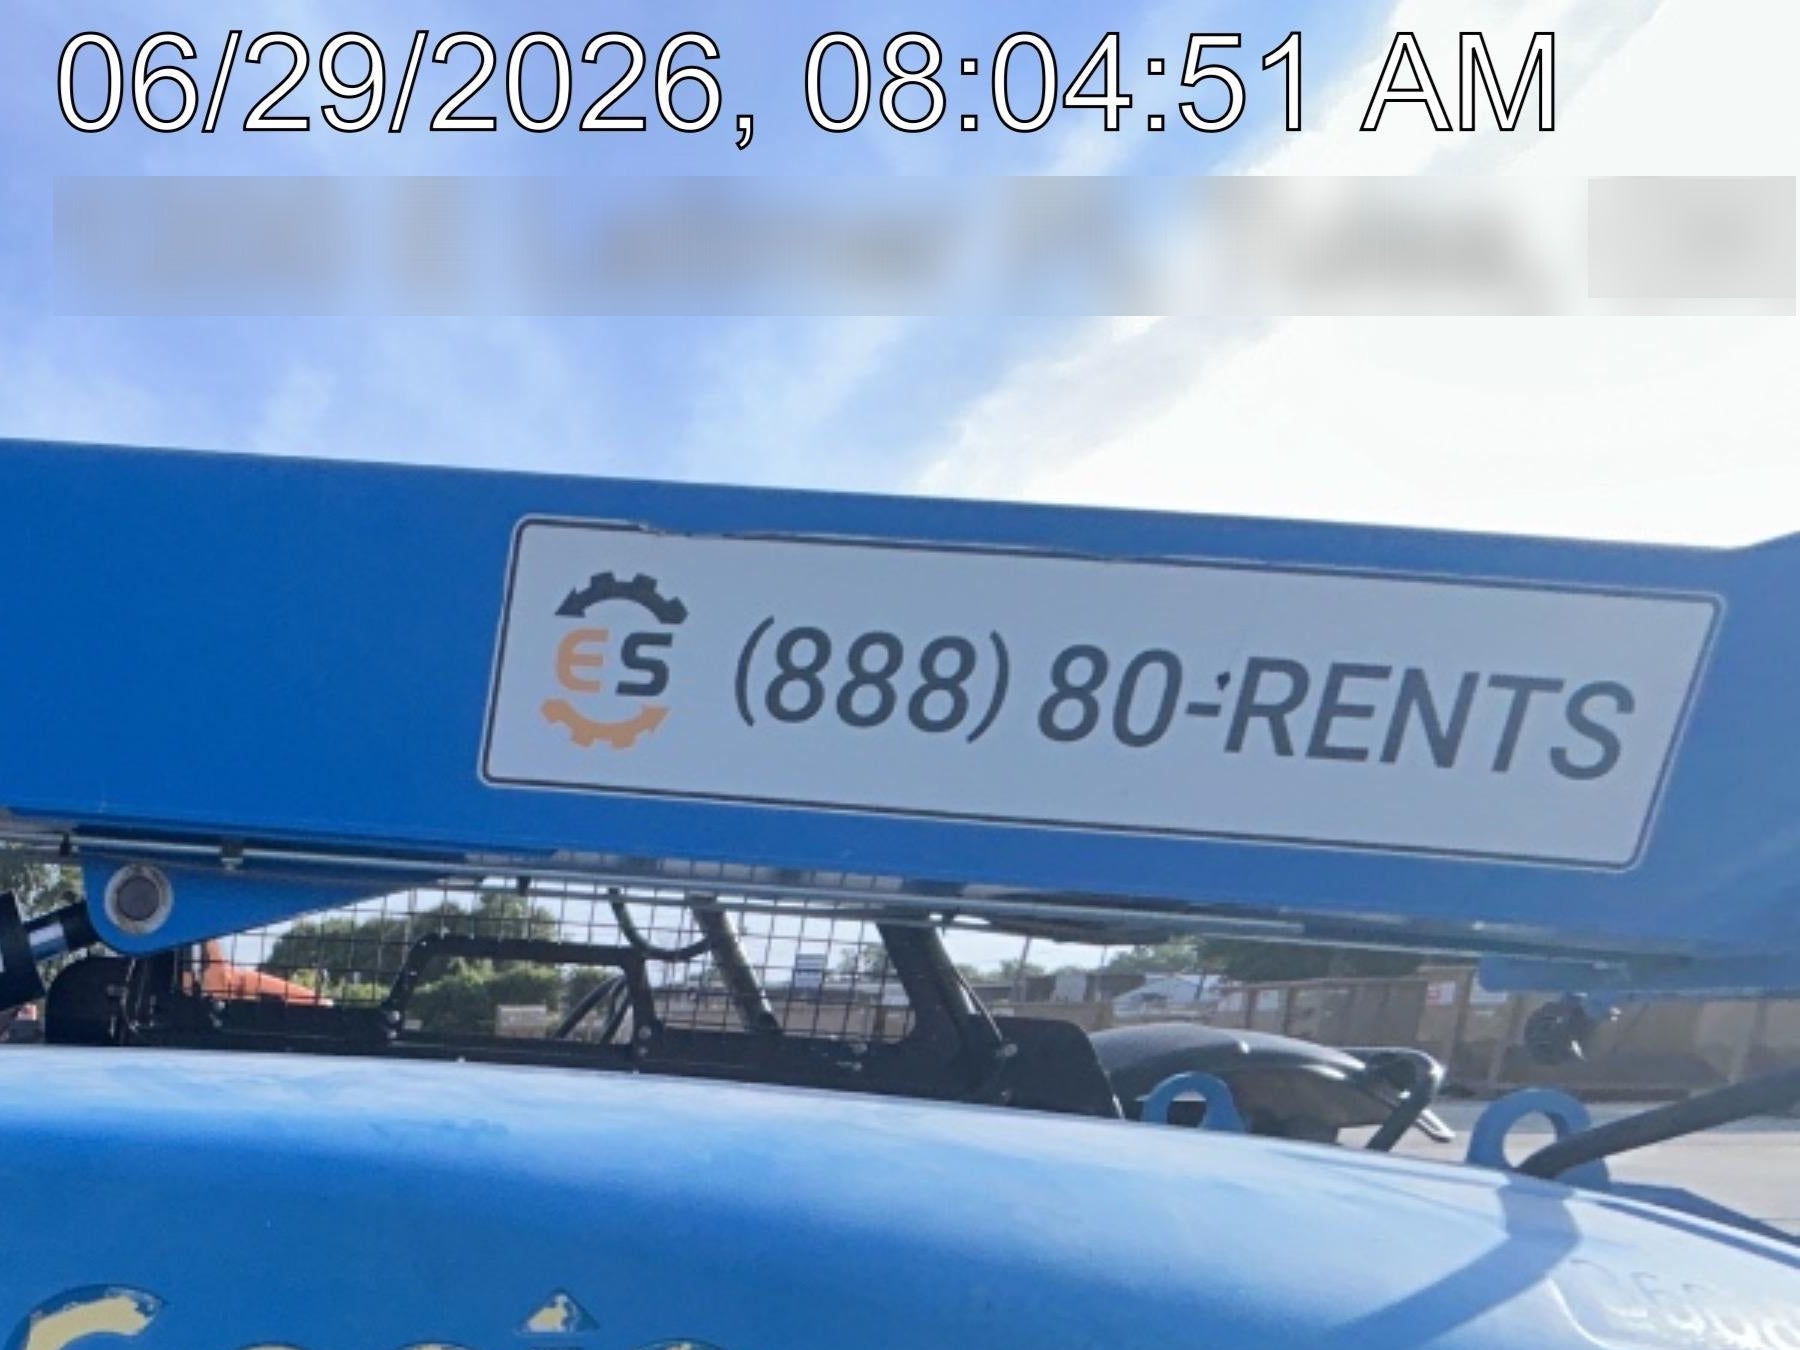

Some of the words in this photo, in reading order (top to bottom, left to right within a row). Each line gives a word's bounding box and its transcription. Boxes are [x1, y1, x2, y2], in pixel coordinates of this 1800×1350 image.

[555, 622, 674, 697] ES
[734, 617, 1011, 746] (888)
[1037, 642, 1636, 781] 80-RENTS
